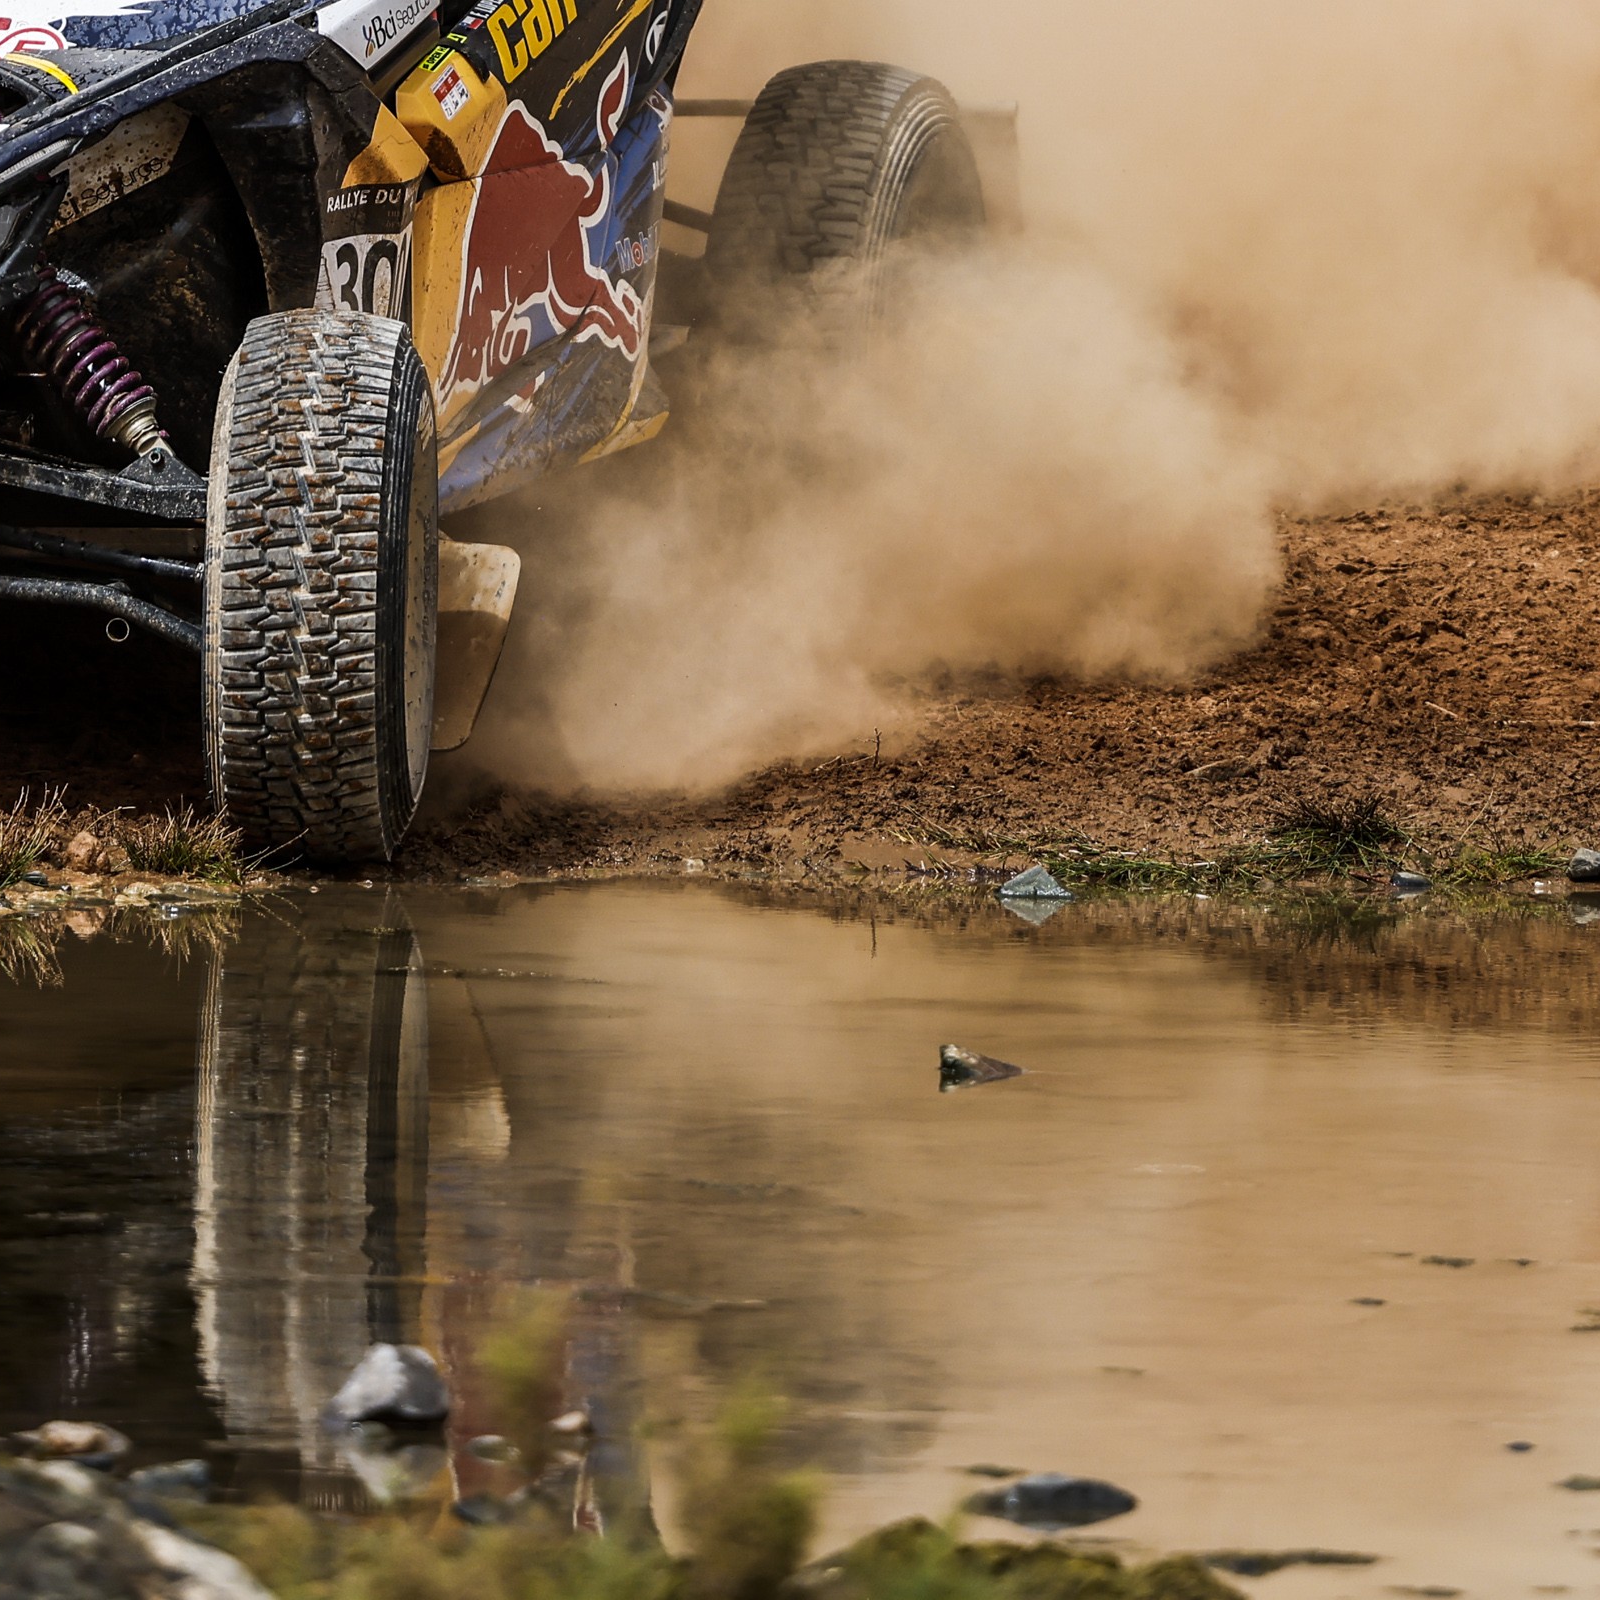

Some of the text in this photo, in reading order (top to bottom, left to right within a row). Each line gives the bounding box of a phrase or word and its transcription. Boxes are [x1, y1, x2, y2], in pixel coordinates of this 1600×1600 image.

[371, 9, 398, 50] Bci
[327, 189, 371, 213] RALLYE
[375, 188, 401, 204] DU
